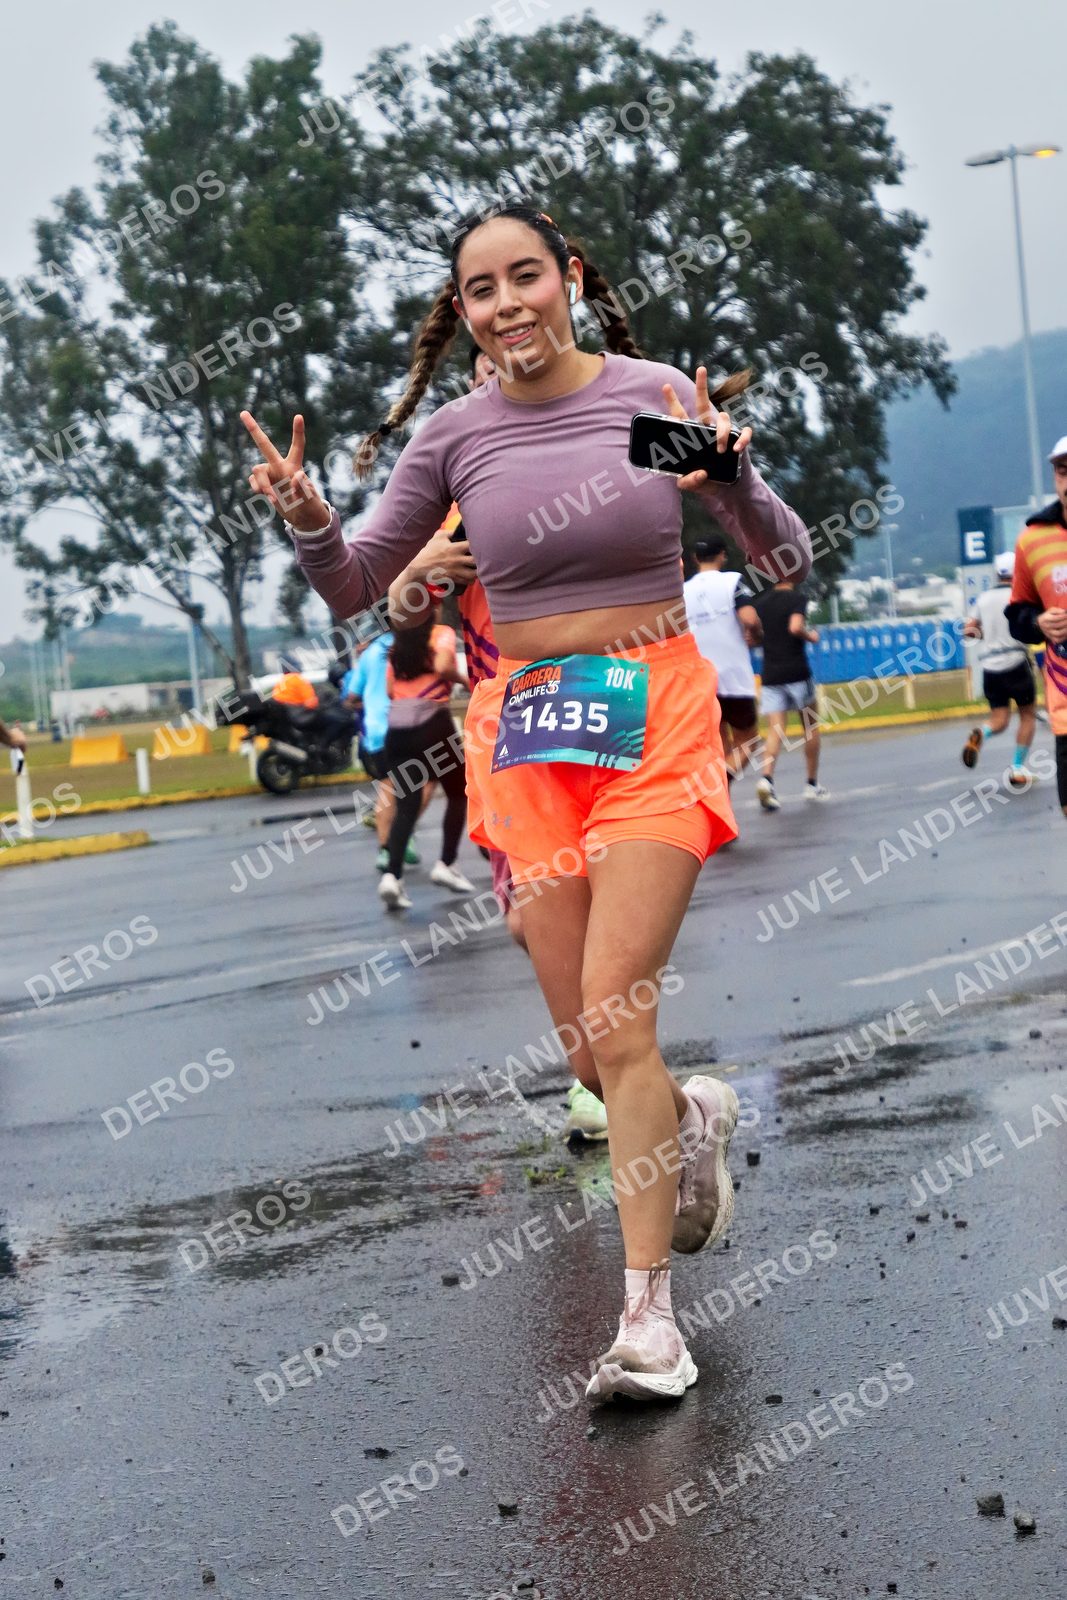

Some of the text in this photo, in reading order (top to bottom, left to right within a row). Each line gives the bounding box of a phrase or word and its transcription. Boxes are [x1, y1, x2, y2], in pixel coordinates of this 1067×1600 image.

[965, 531, 987, 559] E
[511, 665, 562, 695] CARRERA
[605, 666, 638, 691] 10K
[509, 684, 547, 706] OMNILIFE
[520, 700, 610, 735] 1435
